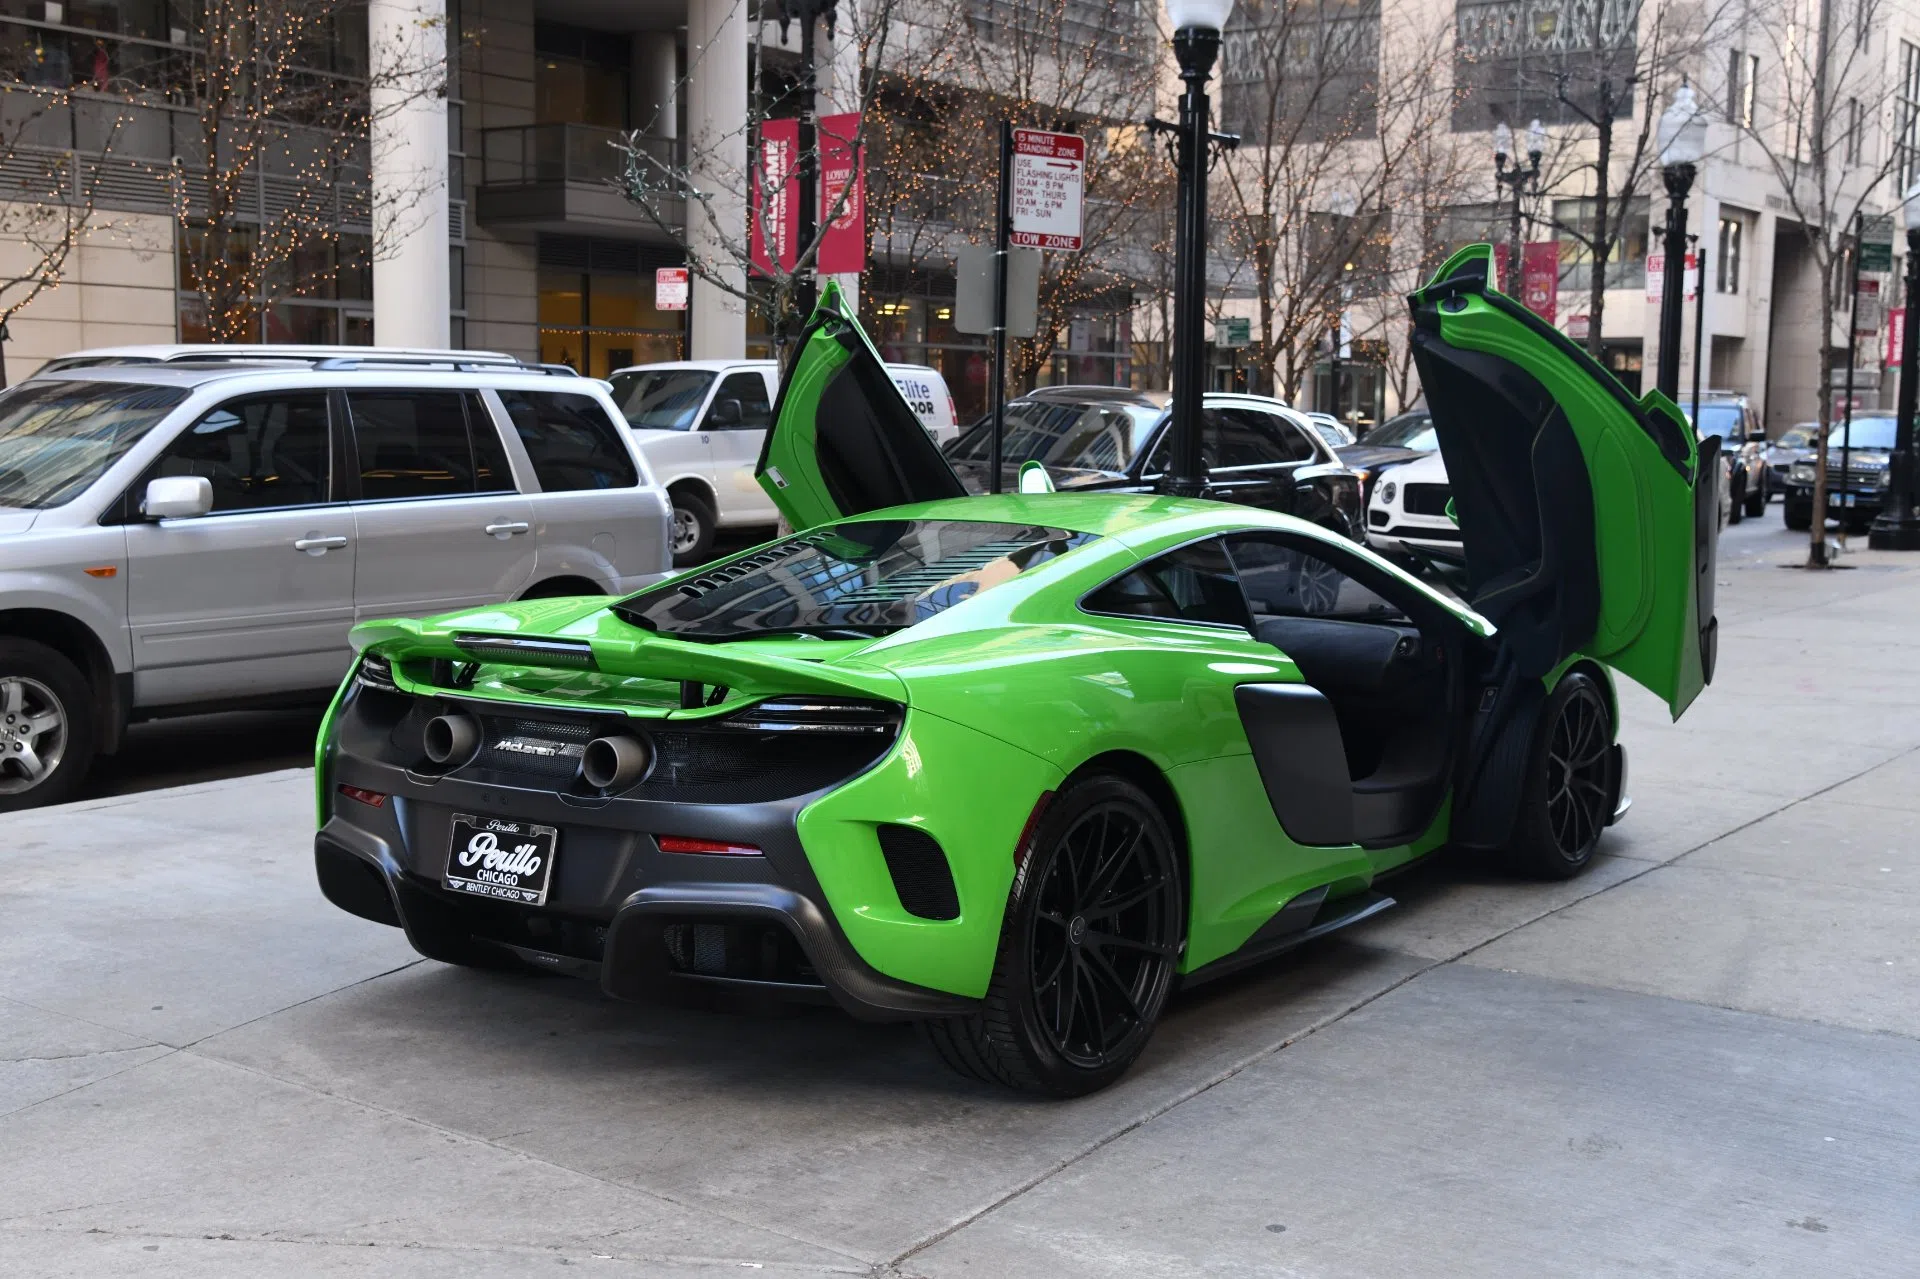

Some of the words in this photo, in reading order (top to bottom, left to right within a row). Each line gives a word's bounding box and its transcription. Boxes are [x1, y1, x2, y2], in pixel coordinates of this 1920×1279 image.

[1018, 133, 1025, 142] 15
[1028, 134, 1055, 146] MINUTE
[1017, 144, 1054, 156] STANDING
[1057, 147, 1077, 158] ZONE
[1017, 159, 1032, 168] USE
[1017, 169, 1053, 181] FLASHING
[1054, 173, 1080, 183] LIGHTS
[1017, 178, 1025, 187] 10
[1025, 179, 1037, 188] AM
[1045, 180, 1051, 189] 8
[1053, 181, 1064, 190] PM
[1016, 188, 1034, 197] MON
[1042, 190, 1067, 200] THURS
[1016, 197, 1025, 206] 10
[1025, 198, 1037, 207] AM
[1044, 199, 1050, 208] 6
[1051, 200, 1063, 209] PM
[1016, 207, 1029, 216] FRI
[1035, 209, 1052, 218] SUN
[778, 221, 787, 257] WATER
[1016, 232, 1040, 245] TOW
[1045, 235, 1076, 249] ZONE
[493, 740, 556, 757] McLaren
[486, 820, 520, 833] Perillo
[458, 832, 542, 877] Perillo
[476, 869, 519, 886] CHICAGO
[466, 882, 491, 895] BENTLEY
[491, 886, 520, 899] CHICAGO
